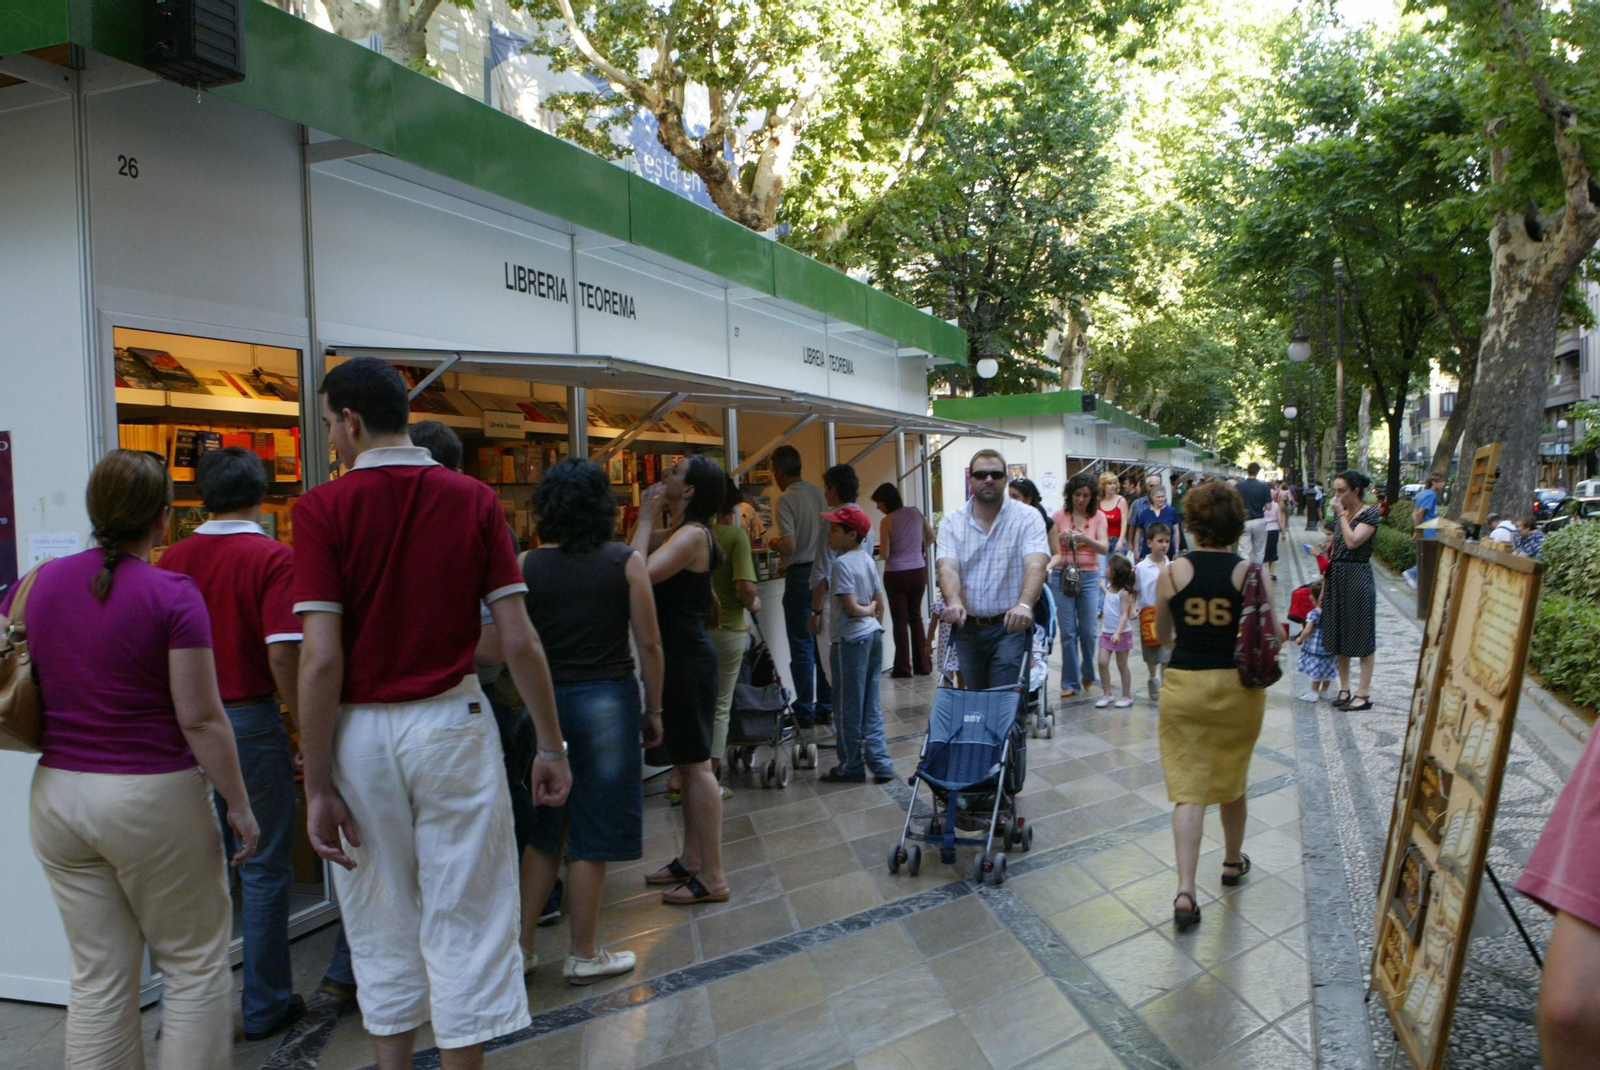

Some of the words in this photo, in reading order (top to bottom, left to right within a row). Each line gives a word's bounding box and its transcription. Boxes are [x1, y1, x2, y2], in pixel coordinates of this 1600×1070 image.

[117, 154, 139, 179] 26
[504, 261, 569, 304] LIBRERIA
[578, 281, 637, 320] TEOREMA
[829, 354, 855, 376] TEOREMA
[1184, 597, 1232, 626] 96
